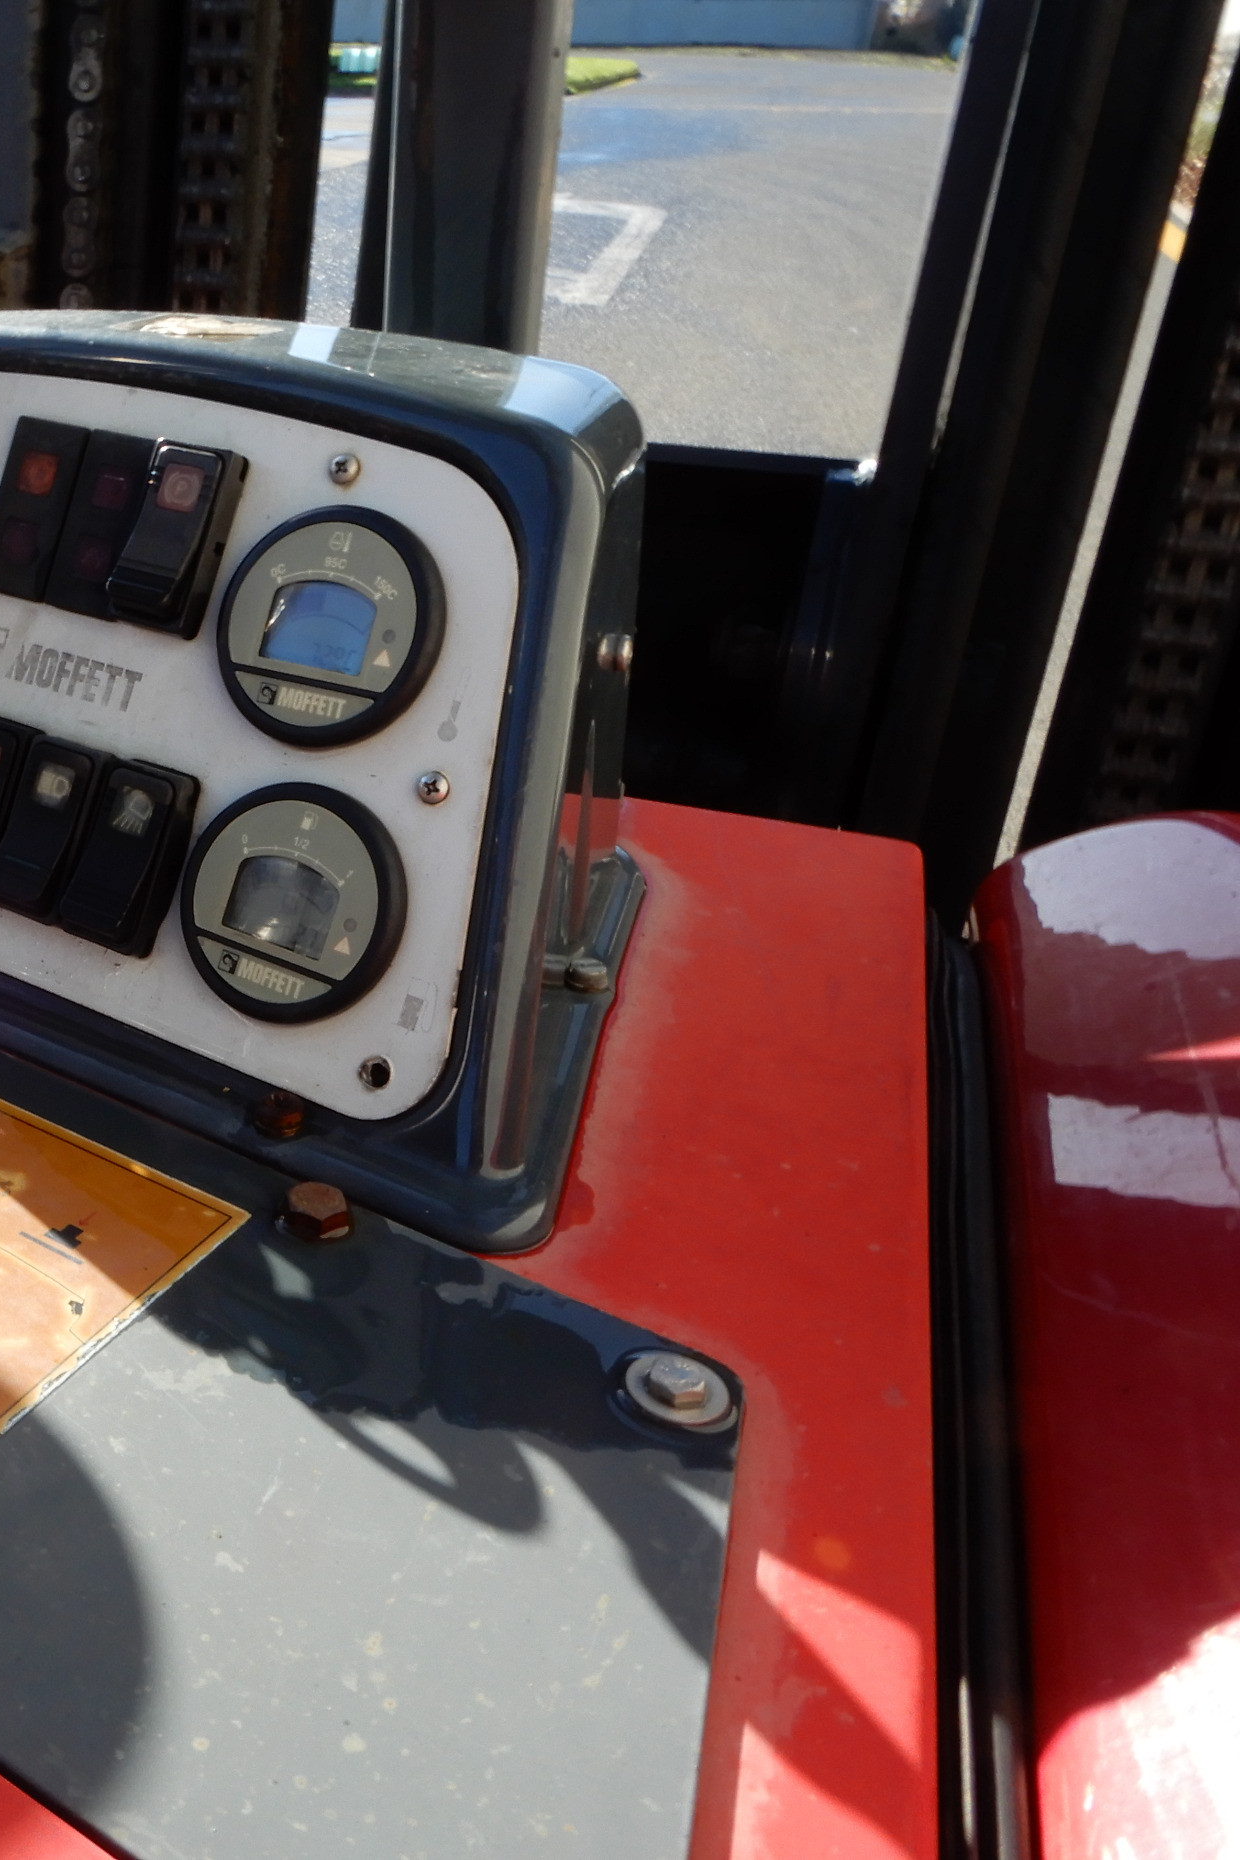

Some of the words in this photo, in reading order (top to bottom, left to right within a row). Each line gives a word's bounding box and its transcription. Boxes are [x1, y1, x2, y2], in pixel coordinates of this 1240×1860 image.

[374, 575, 398, 601] 150C
[6, 642, 143, 713] MOFFETT
[277, 686, 347, 719] MOFFETT
[293, 836, 311, 850] 1/2
[237, 957, 305, 999] MOFFETT
